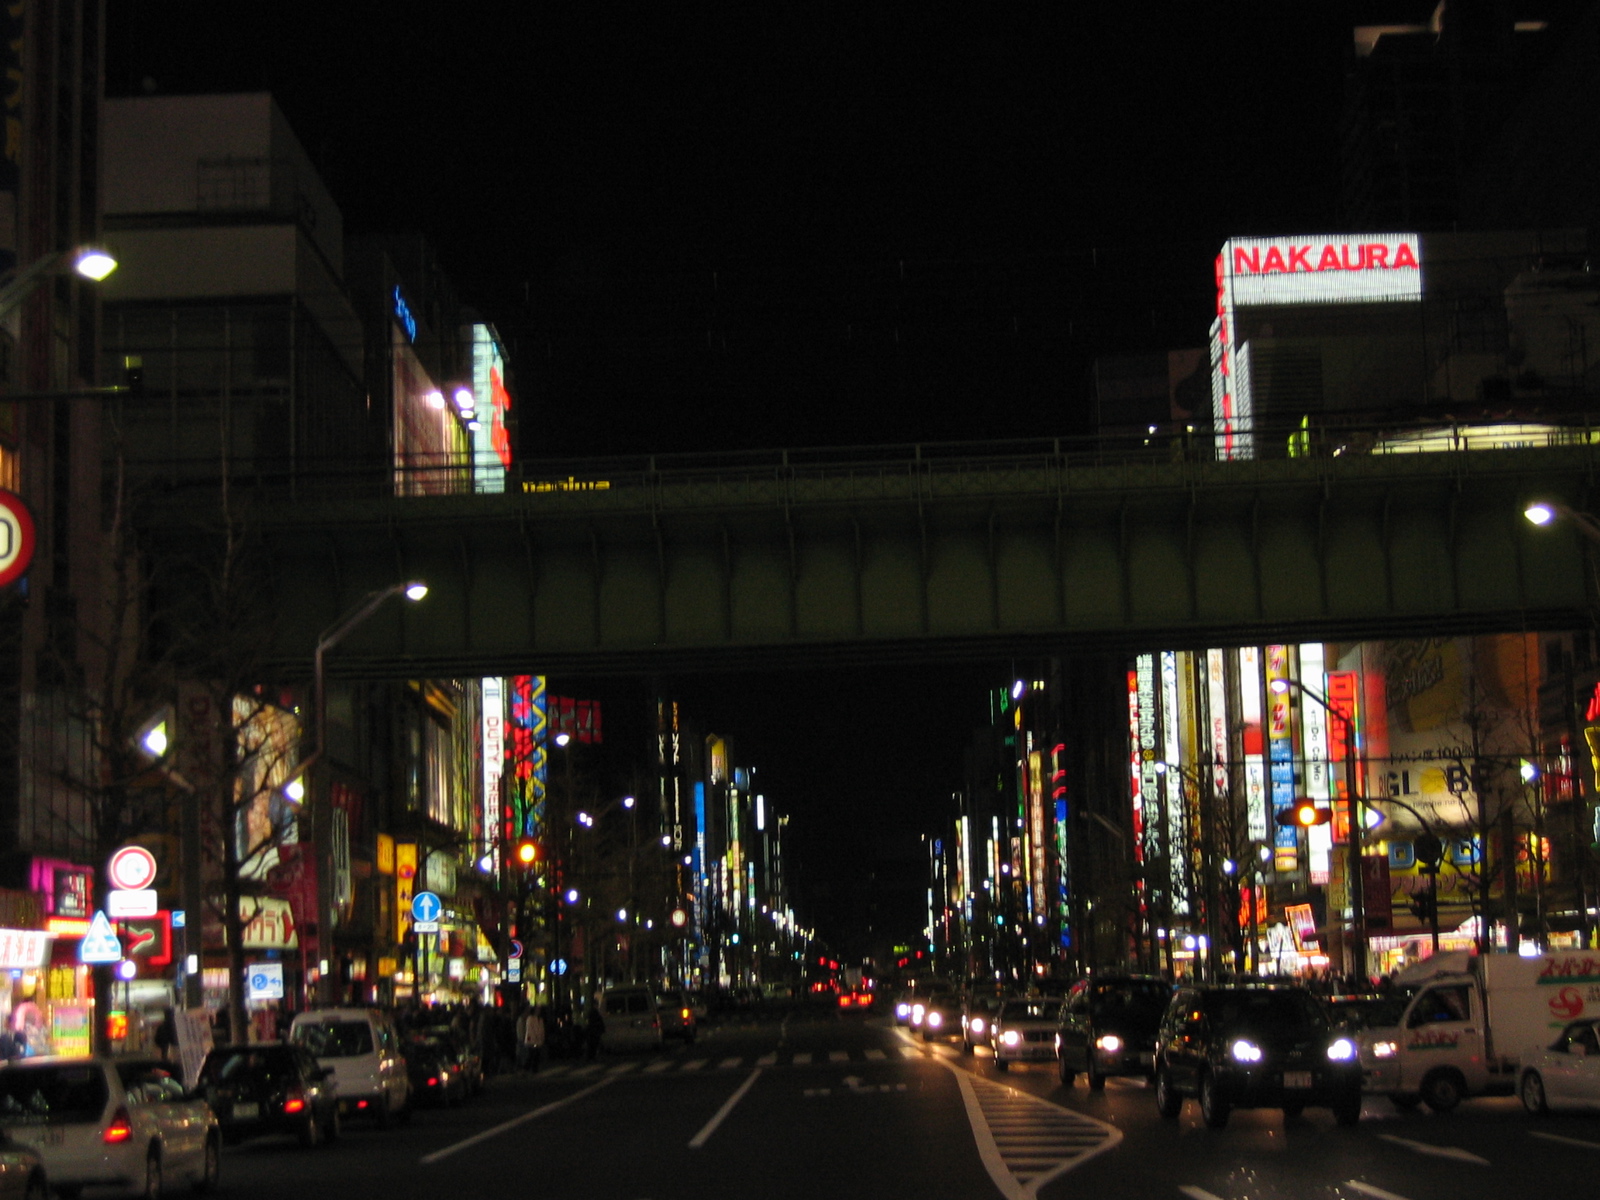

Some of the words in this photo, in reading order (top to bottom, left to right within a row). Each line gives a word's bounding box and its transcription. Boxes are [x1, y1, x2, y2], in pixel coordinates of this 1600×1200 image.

[1234, 243, 1419, 274] NAKAURA
[486, 716, 500, 762] DUTY
[488, 771, 501, 816] FREE
